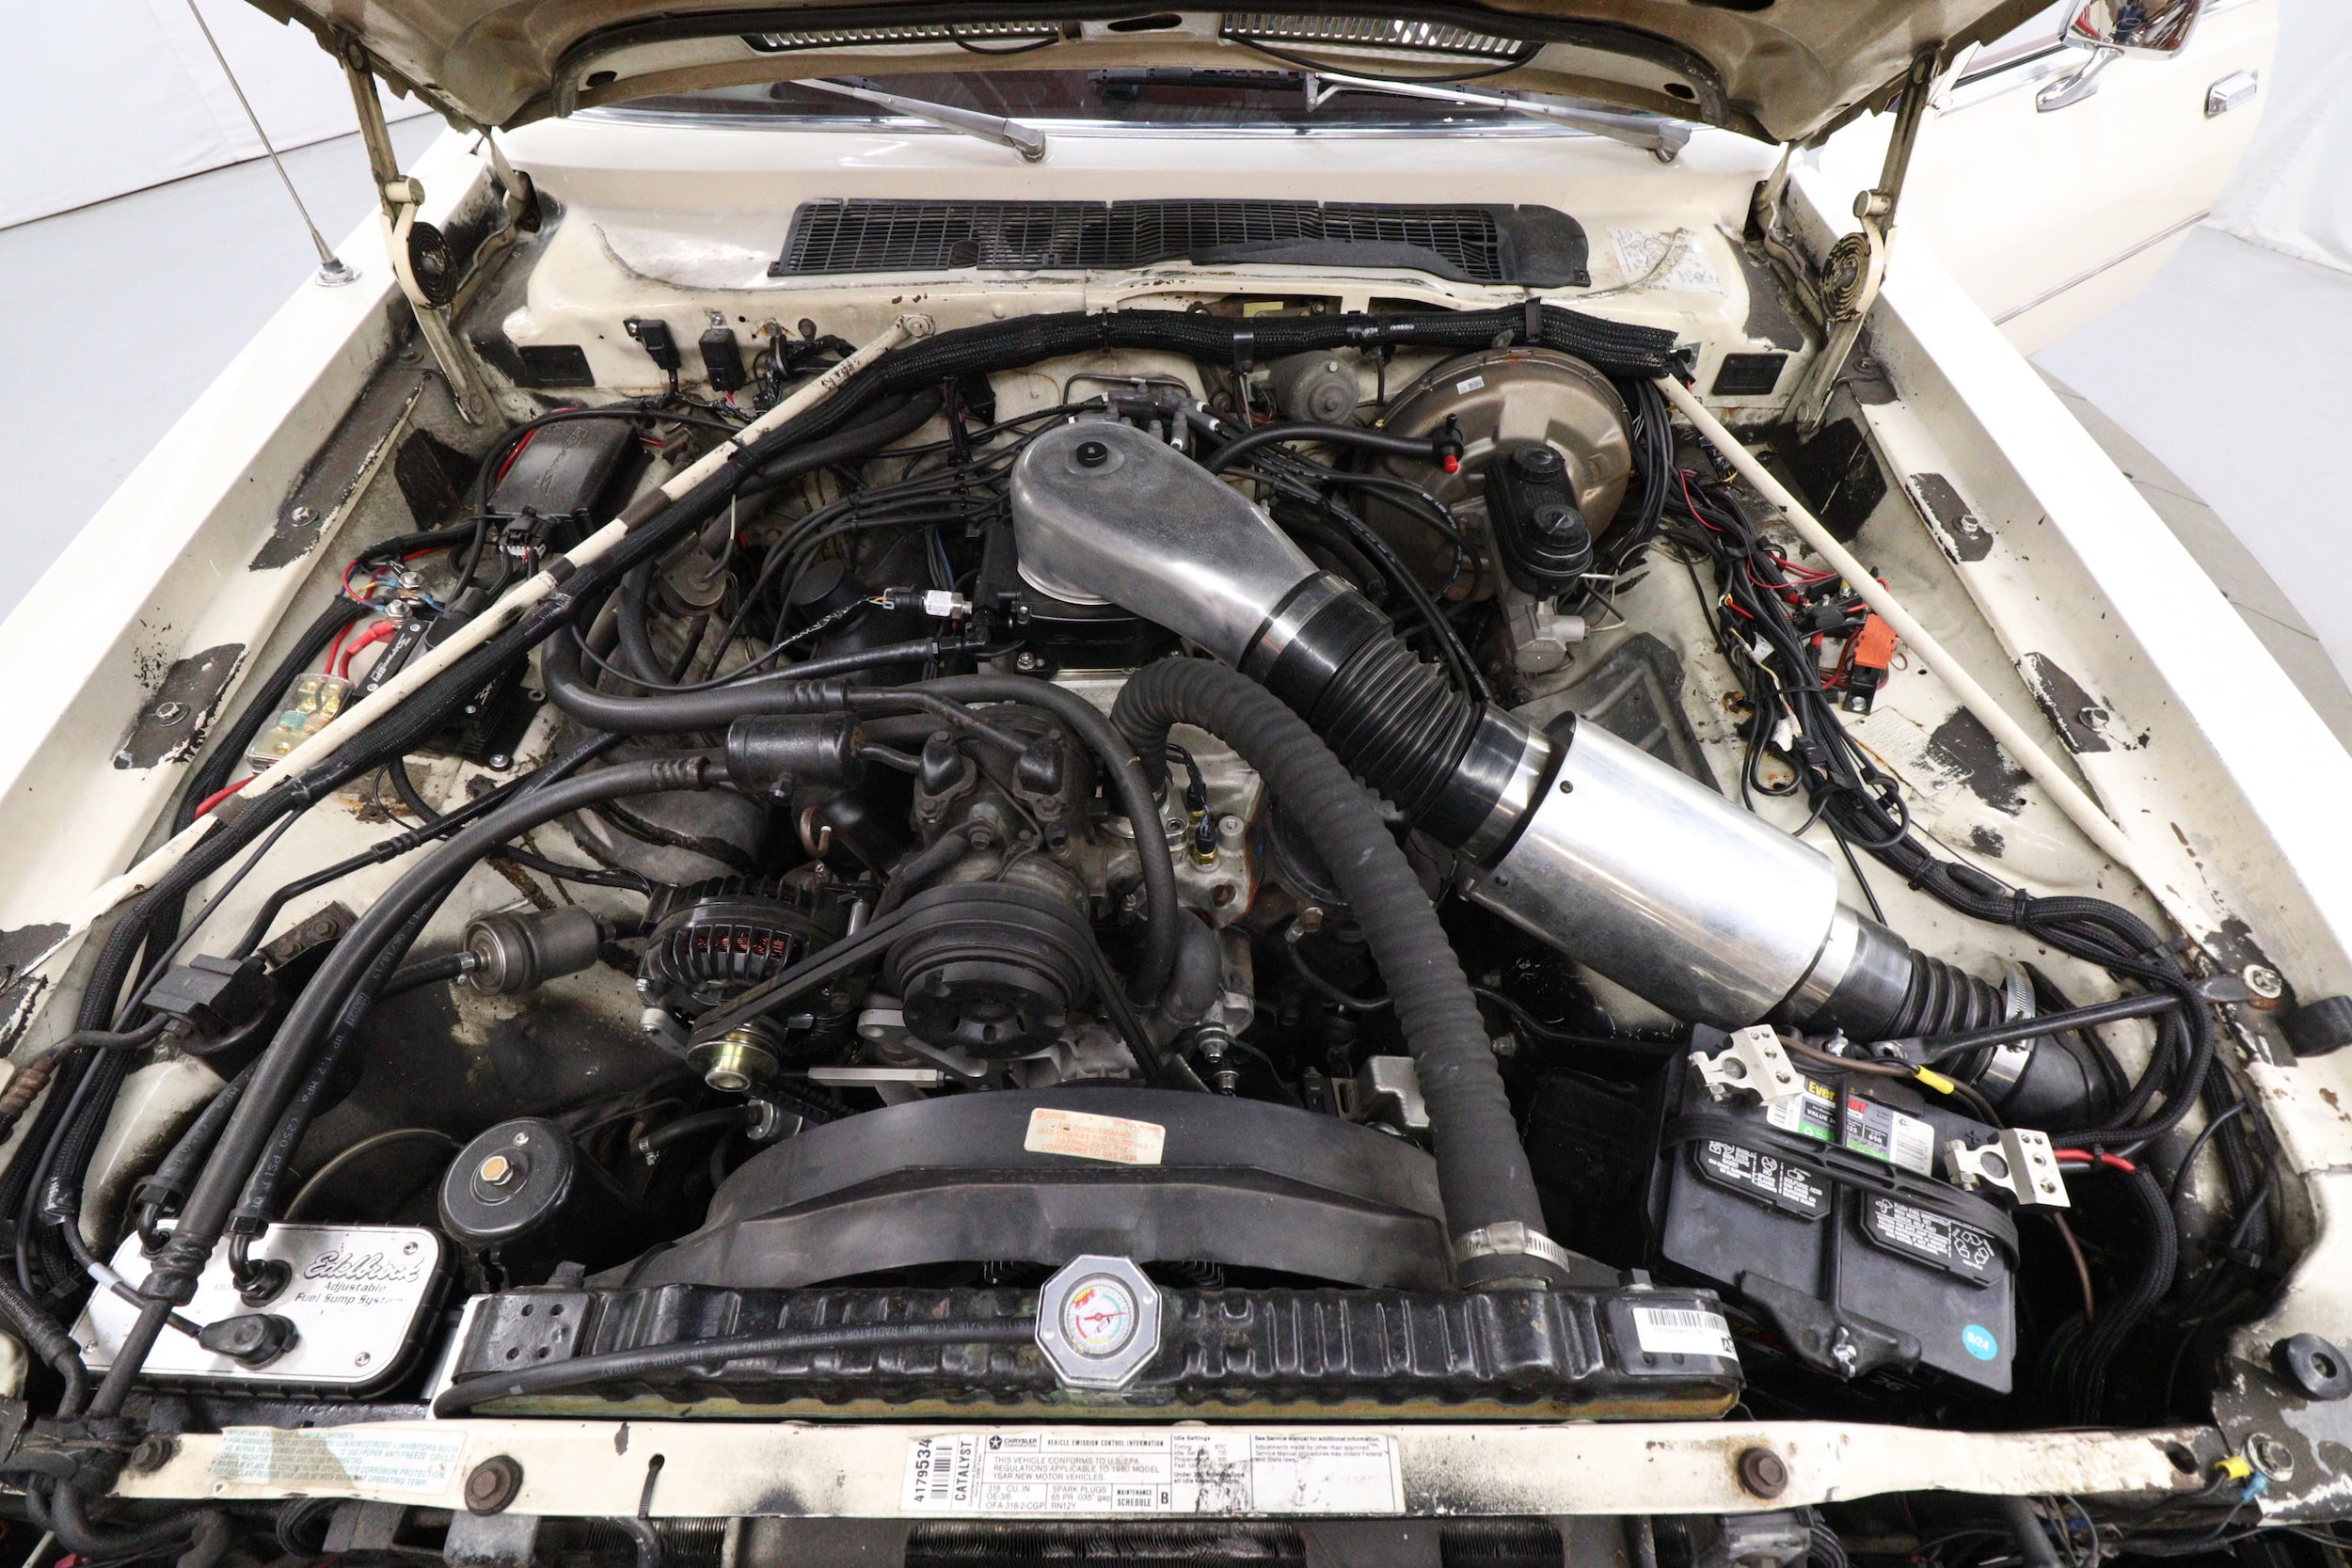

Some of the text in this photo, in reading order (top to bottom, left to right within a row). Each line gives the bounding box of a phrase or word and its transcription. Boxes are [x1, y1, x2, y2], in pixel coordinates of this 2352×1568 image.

[372, 933, 405, 980] 06/18/19
[1806, 1109, 1828, 1122] VALUE
[303, 1250, 425, 1283] Edelbrock
[324, 1281, 387, 1293] Adjustable
[294, 1292, 320, 1303] Fuel
[325, 1293, 356, 1306] Sump
[787, 1330, 841, 1346] OVERFLOW
[845, 1326, 898, 1340] RADIATOR
[708, 1342, 738, 1357] MADE
[741, 1338, 781, 1353] TUBING
[649, 1351, 686, 1365] CHINA
[690, 1348, 704, 1360] IN
[429, 1453, 455, 1462] COULD
[400, 1468, 445, 1479] PROTECTION
[914, 1438, 932, 1503] 4179534
[955, 1441, 972, 1501] CATALYST
[1118, 1498, 1152, 1507] SCHEDULE
[1161, 1492, 1168, 1504] B
